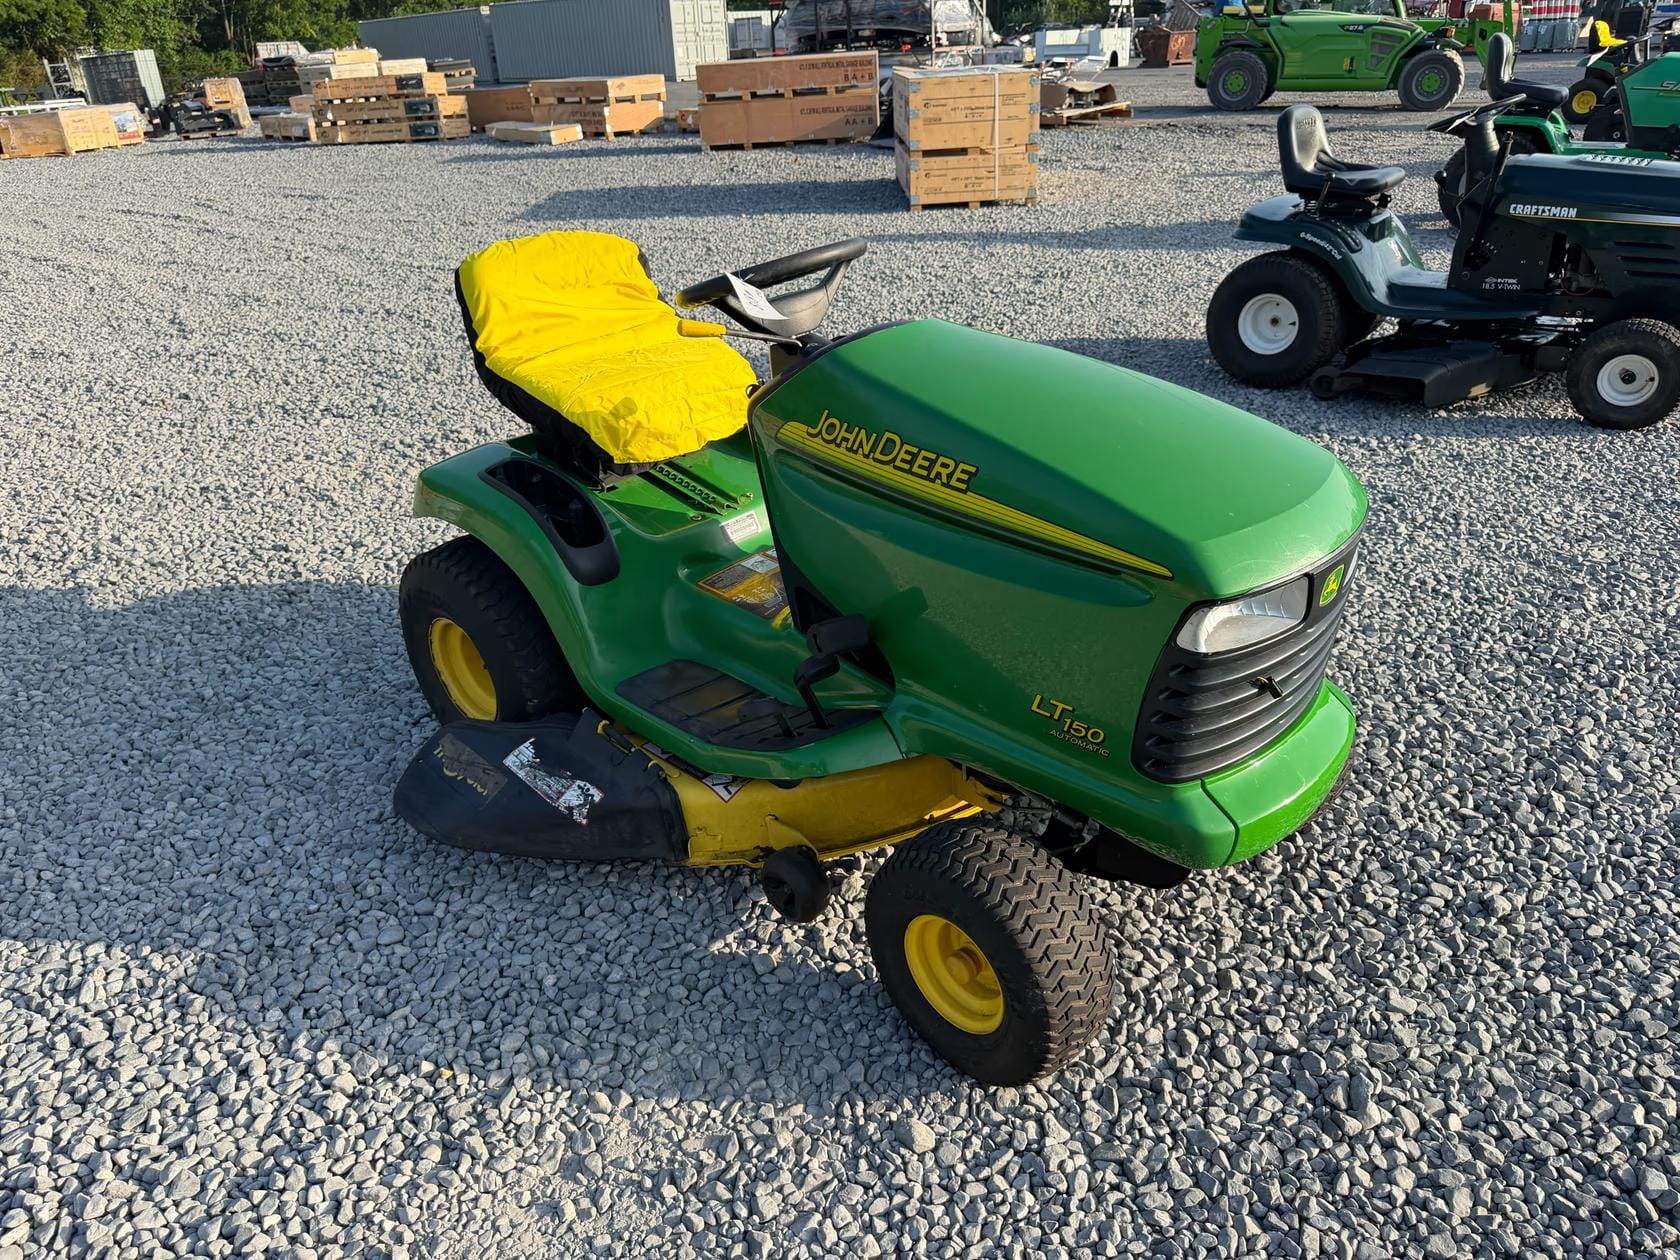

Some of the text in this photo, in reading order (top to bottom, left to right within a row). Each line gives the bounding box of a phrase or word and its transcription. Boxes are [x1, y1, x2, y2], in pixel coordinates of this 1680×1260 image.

[1509, 203, 1578, 218] CRAFTSMAN
[1031, 694, 1073, 721] LT
[1049, 729, 1110, 757] AUTOMATIC
[1063, 718, 1105, 743] 150
